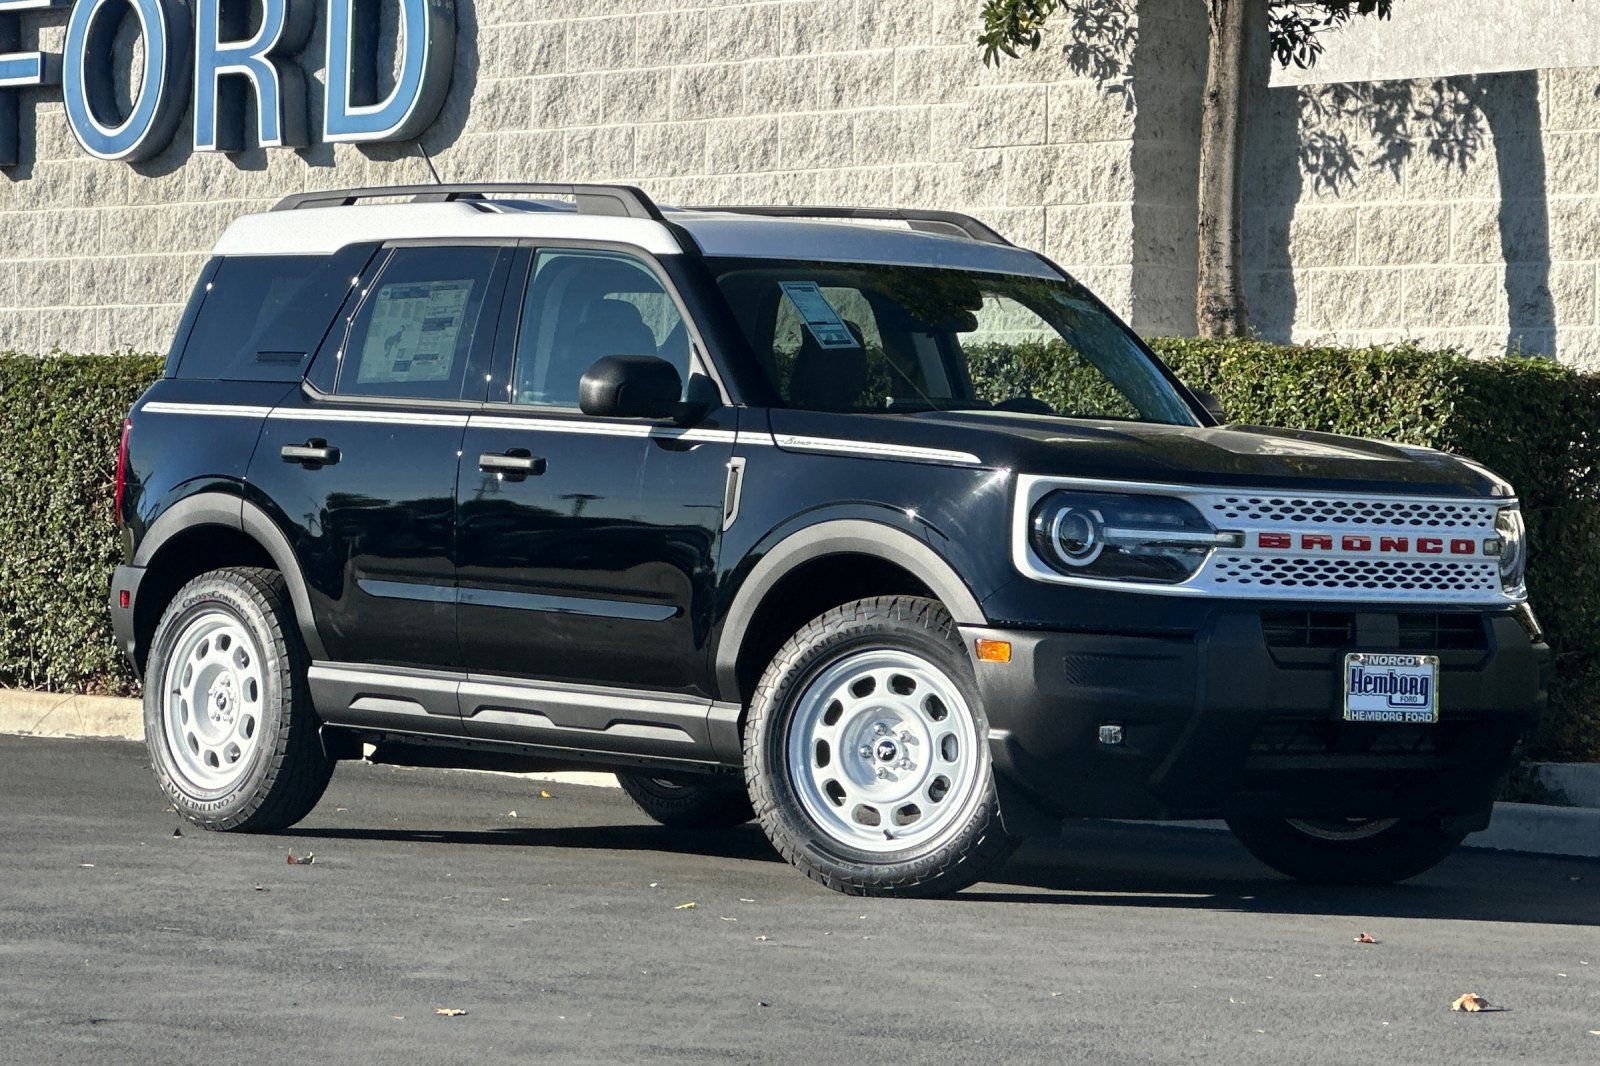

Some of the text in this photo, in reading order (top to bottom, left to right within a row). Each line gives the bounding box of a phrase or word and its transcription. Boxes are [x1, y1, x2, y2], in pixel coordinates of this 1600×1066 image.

[1258, 532, 1475, 555] BRONCO
[1368, 655, 1415, 666] NORCO
[1350, 668, 1429, 706] Hemborg
[1400, 695, 1418, 703] FORD
[1351, 711, 1433, 722] HEMBORG FORD
